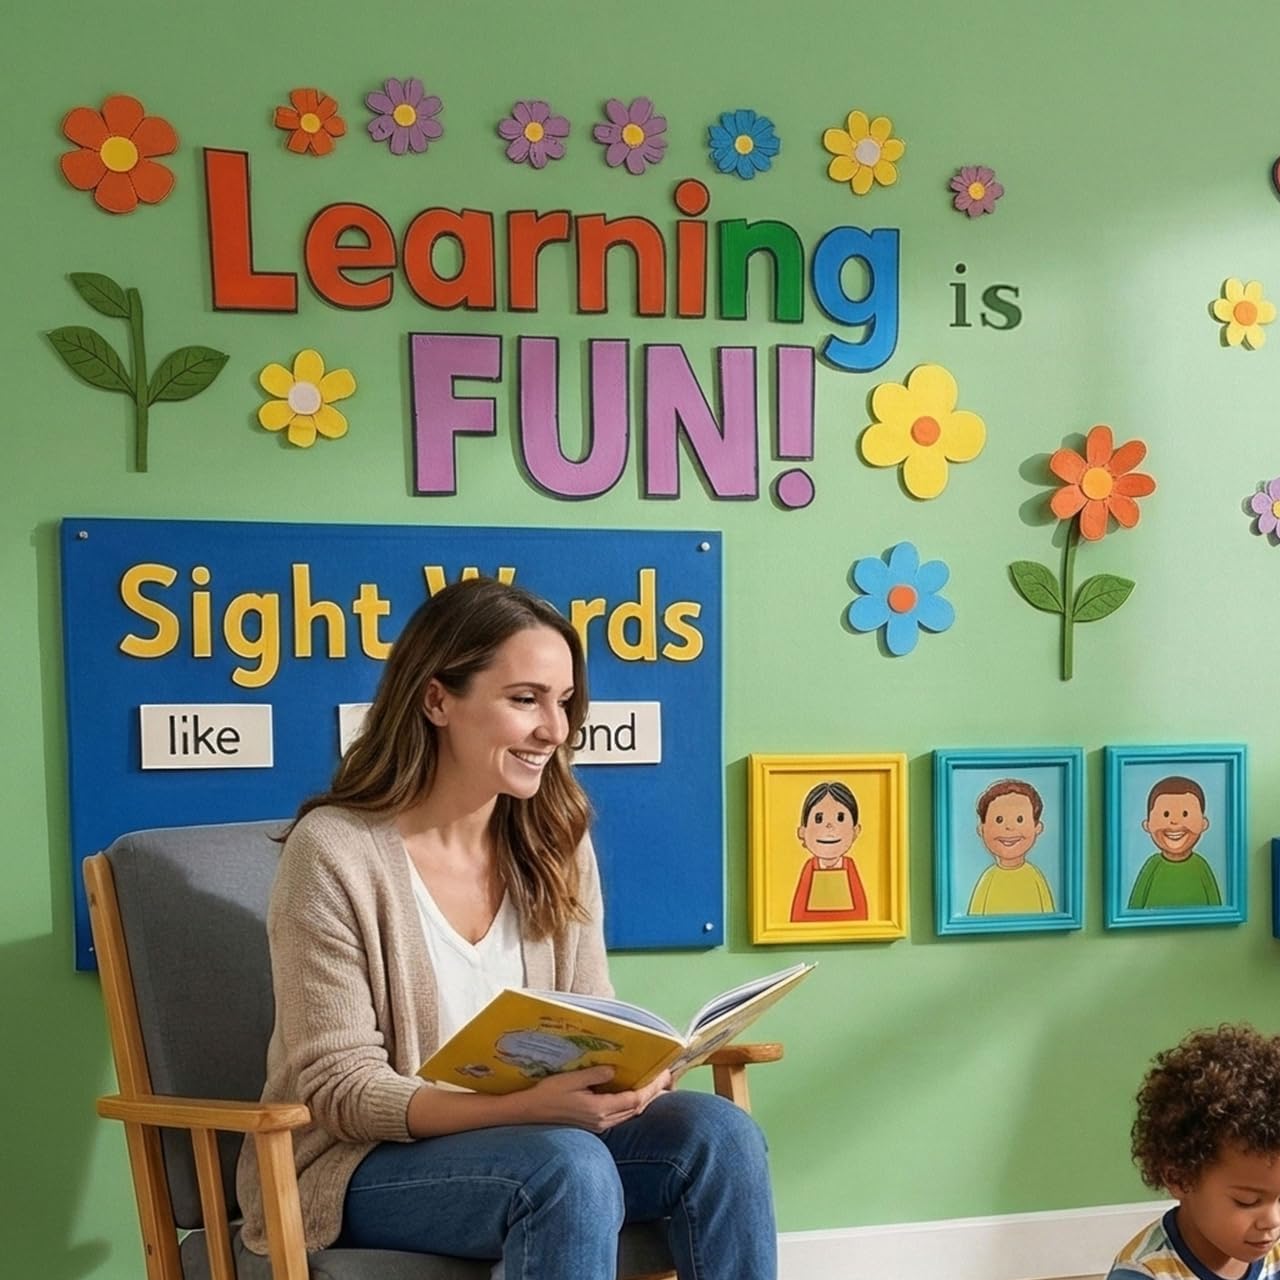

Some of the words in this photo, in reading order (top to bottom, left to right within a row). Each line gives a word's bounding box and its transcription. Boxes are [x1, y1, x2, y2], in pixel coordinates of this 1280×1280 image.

[203, 146, 901, 373] Learning
[948, 263, 1022, 332] is
[408, 332, 816, 510] FUN!
[119, 562, 392, 689] Sight
[424, 565, 705, 663] rds
[168, 714, 241, 756] like
